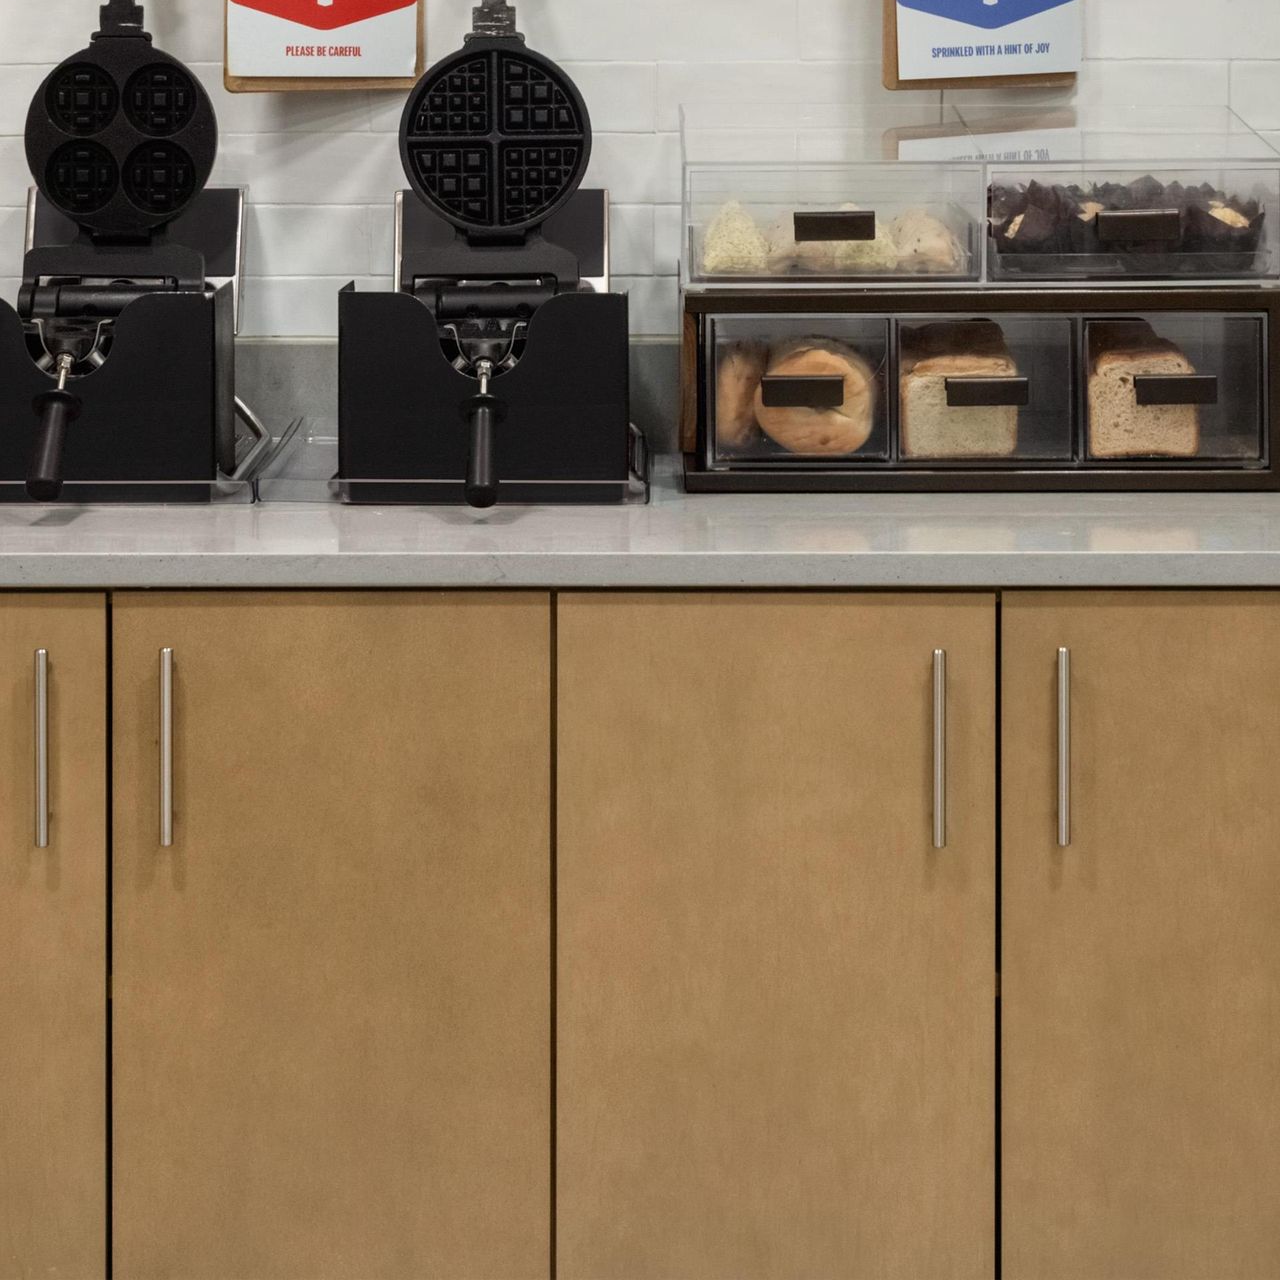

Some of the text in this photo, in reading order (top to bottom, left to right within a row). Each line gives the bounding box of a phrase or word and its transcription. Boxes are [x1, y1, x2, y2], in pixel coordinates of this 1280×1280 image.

[285, 46, 362, 57] PLEASE BE CAREFUL
[932, 43, 1050, 58] SPRINKLED WITH A HINT OF JOY
